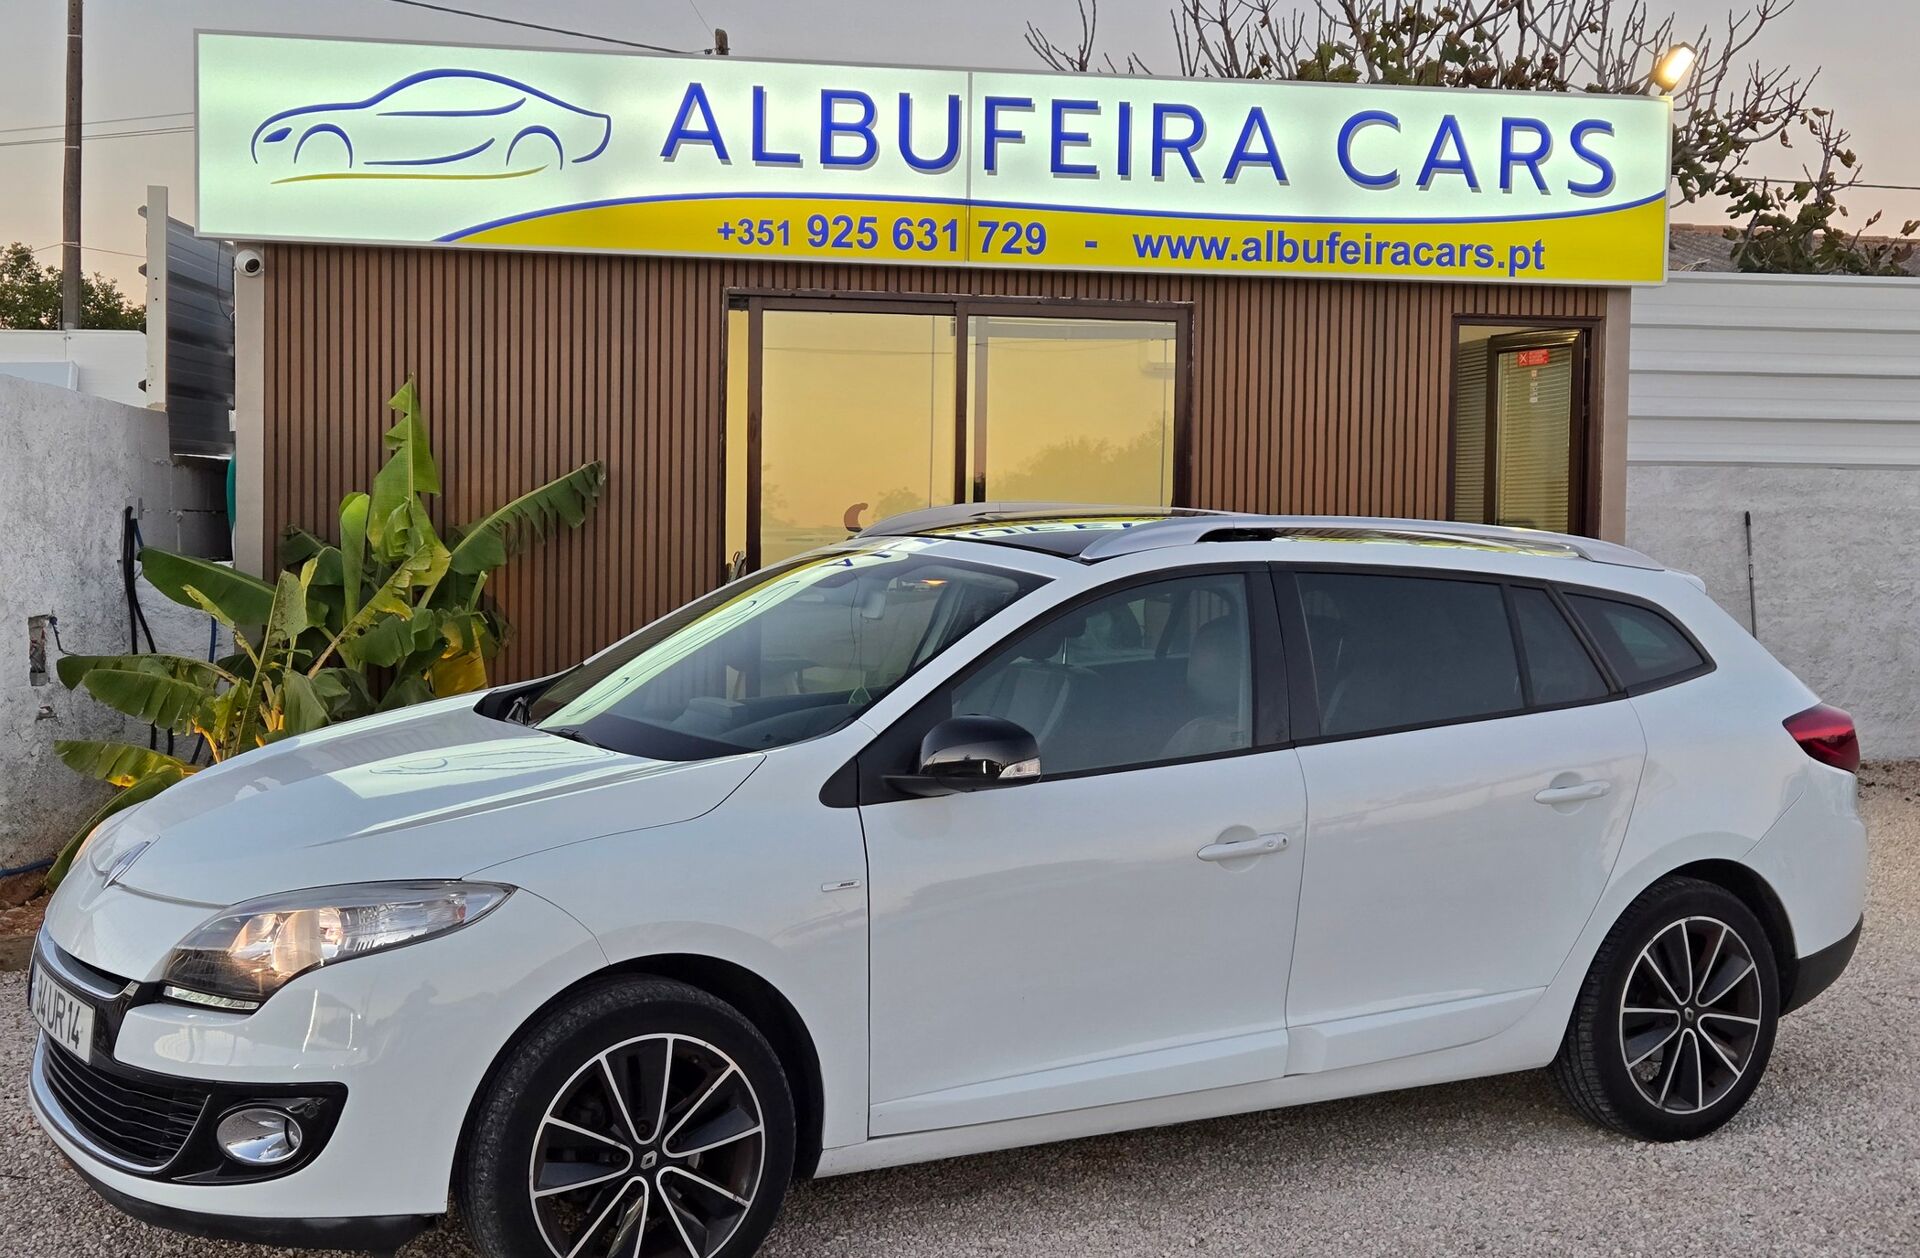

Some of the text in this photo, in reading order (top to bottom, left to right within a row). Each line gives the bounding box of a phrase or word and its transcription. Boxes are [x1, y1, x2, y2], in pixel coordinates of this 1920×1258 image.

[660, 82, 1614, 195] ALBUFEIRA CARS
[717, 218, 790, 246] +351
[806, 214, 879, 250] 925
[892, 218, 958, 252] 631
[978, 220, 1046, 255] 729
[1132, 229, 1546, 277] www.albufeiracars.pt
